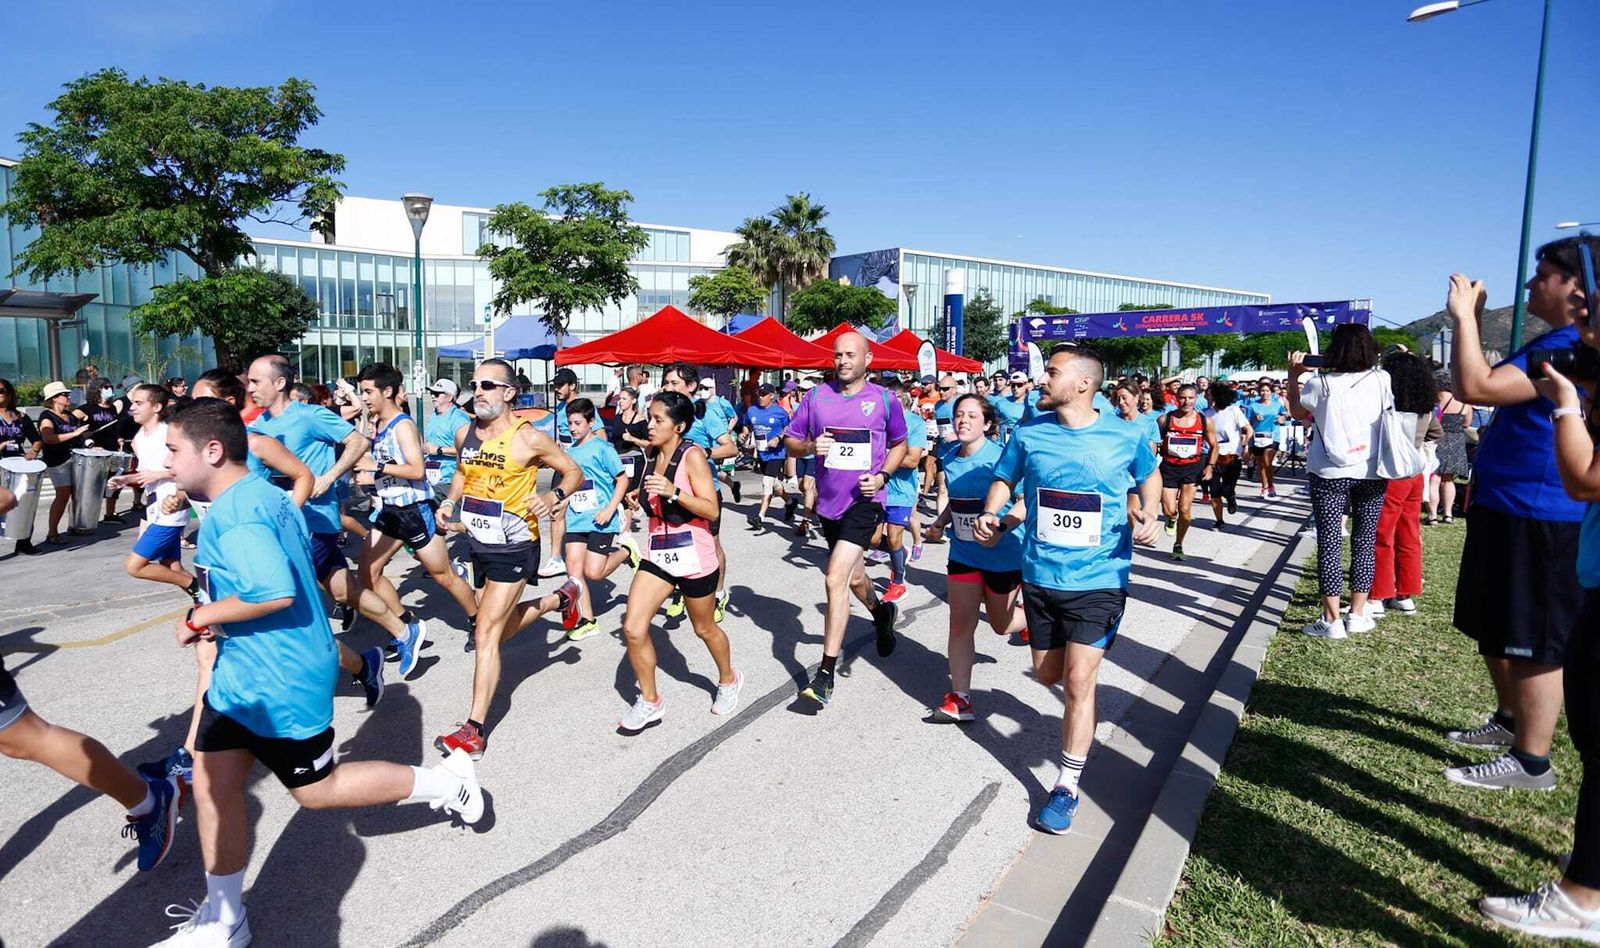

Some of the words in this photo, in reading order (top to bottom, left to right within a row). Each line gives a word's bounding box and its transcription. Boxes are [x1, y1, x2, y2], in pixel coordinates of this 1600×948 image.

[1142, 314, 1188, 323] CARRERA
[1191, 313, 1205, 321] 5K
[461, 447, 505, 463] bichos
[840, 446, 854, 457] 22
[383, 477, 398, 489] 572
[574, 493, 588, 502] 735
[471, 518, 491, 530] 405
[958, 517, 976, 528] 745
[1053, 513, 1082, 529] 309
